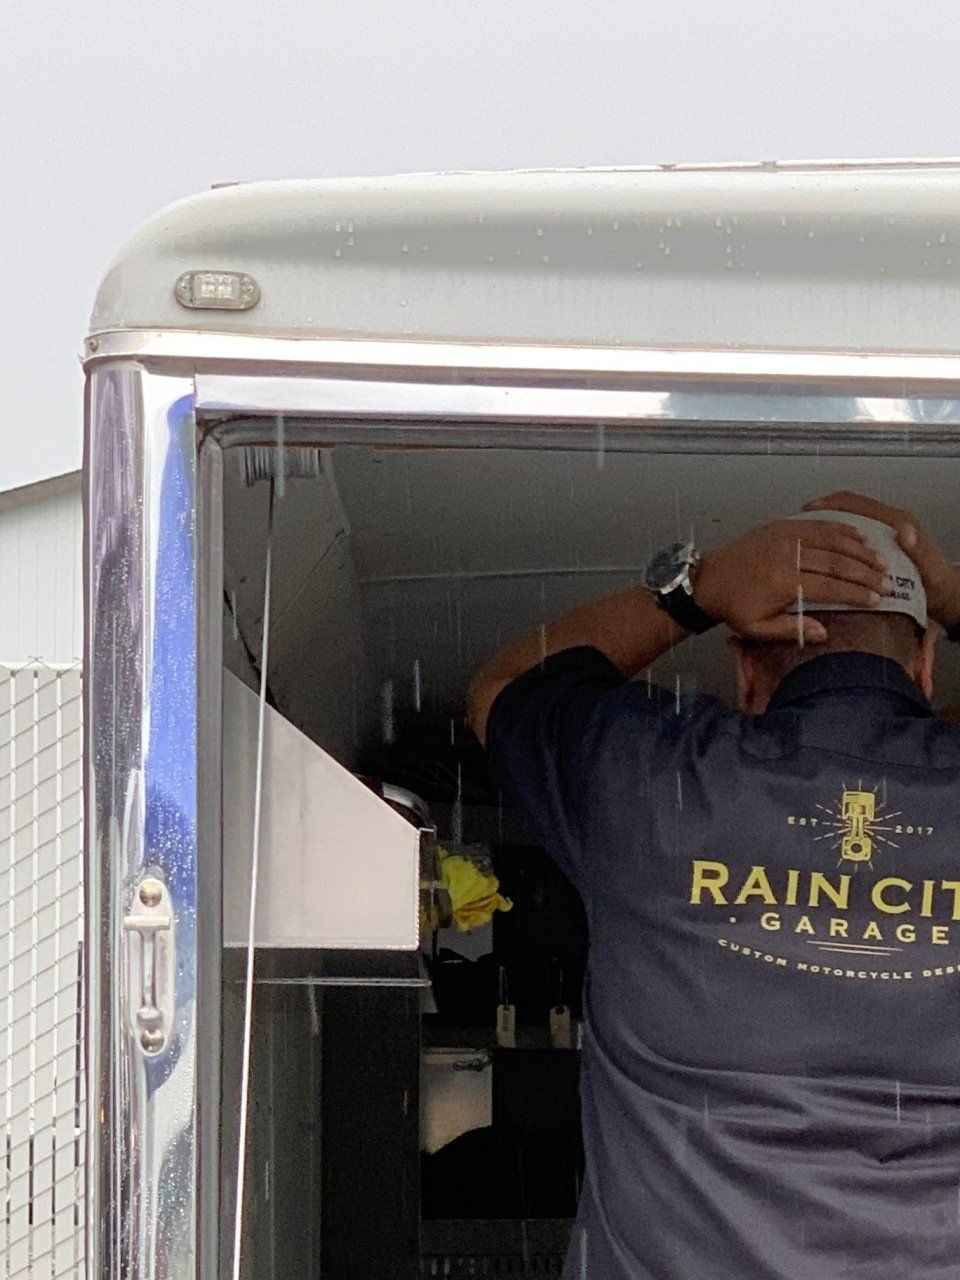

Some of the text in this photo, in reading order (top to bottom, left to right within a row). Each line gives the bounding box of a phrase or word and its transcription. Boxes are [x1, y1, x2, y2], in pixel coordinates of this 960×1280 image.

[787, 816, 934, 835] EST 2017
[690, 859, 851, 910] RAIN
[760, 912, 950, 945] GARAGE
[717, 938, 788, 967] CUSTOM
[796, 962, 914, 980] MOTORCYCLE
